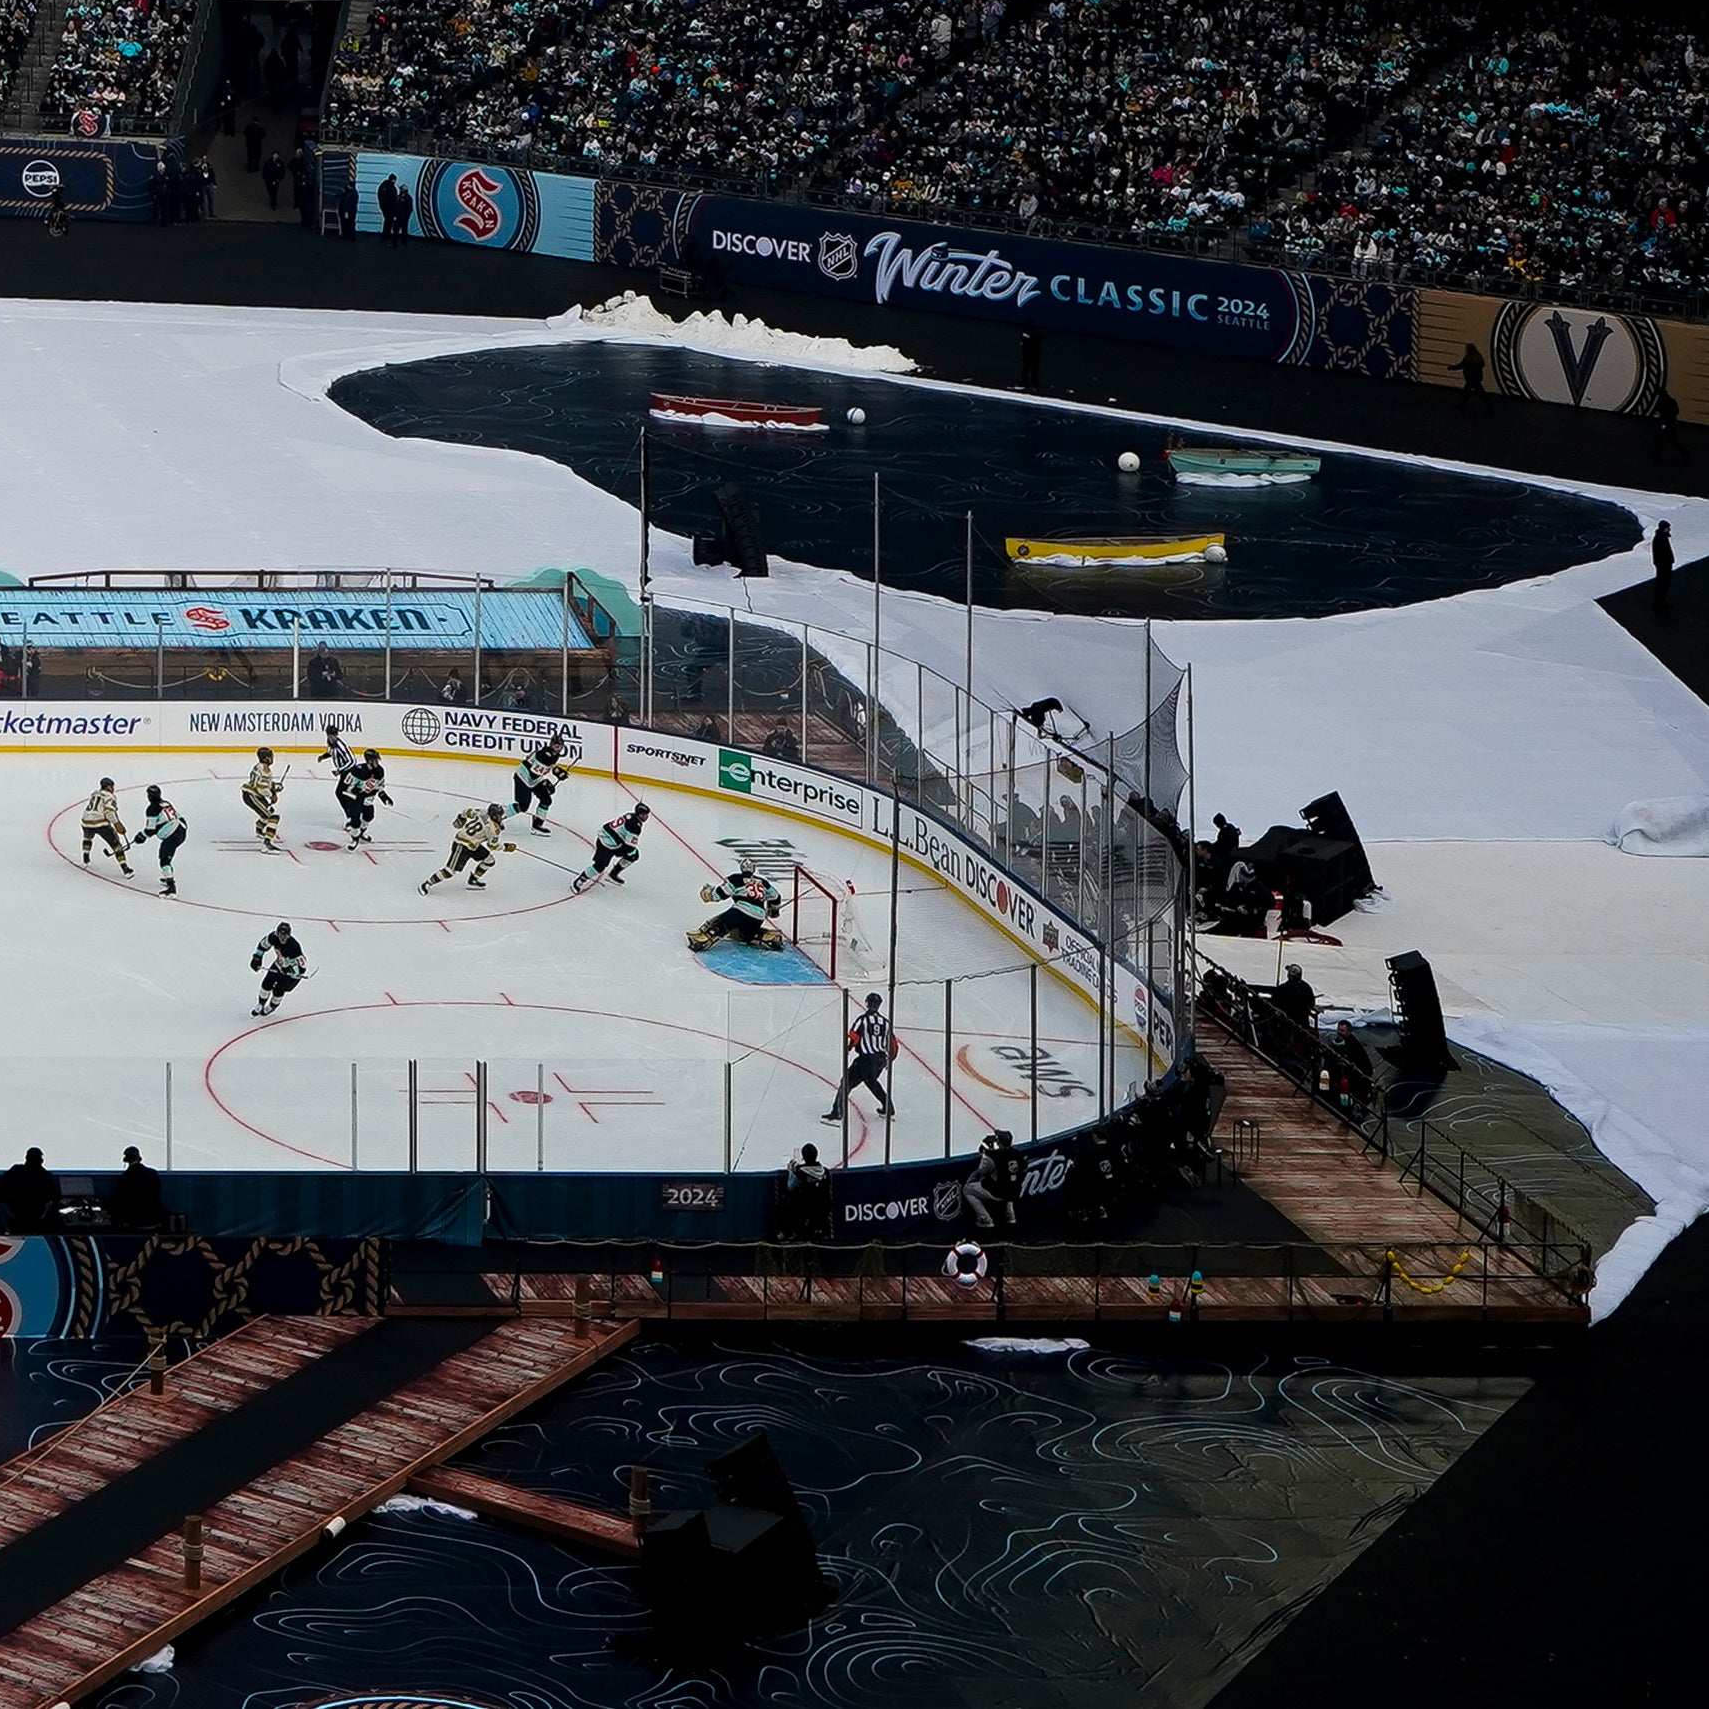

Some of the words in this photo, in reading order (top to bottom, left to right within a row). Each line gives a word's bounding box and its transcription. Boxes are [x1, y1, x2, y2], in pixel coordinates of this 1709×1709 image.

[24, 171, 57, 185] PEPSI
[461, 179, 496, 231] KRAKEN
[713, 230, 812, 263] DISCOVER
[827, 245, 850, 267] NHL
[864, 232, 1041, 307] Winter
[1050, 272, 1209, 323] CLASSIC
[1216, 296, 1270, 319] 2024
[1216, 315, 1270, 331] SEATTLE
[238, 608, 432, 631] KRAKEN
[189, 712, 227, 732] NEW
[230, 712, 315, 732] AMSTERDAM
[319, 712, 363, 733] VODKA
[444, 711, 498, 733] NAVY
[501, 715, 582, 739] FEDERAL
[444, 733, 516, 751] CREDIT
[627, 742, 706, 767] SPORTSNET
[722, 755, 860, 815] enterprise
[965, 860, 1036, 939] DISCOVER
[667, 1188, 719, 1208] 2024
[845, 1195, 930, 1225] DISCOVER
